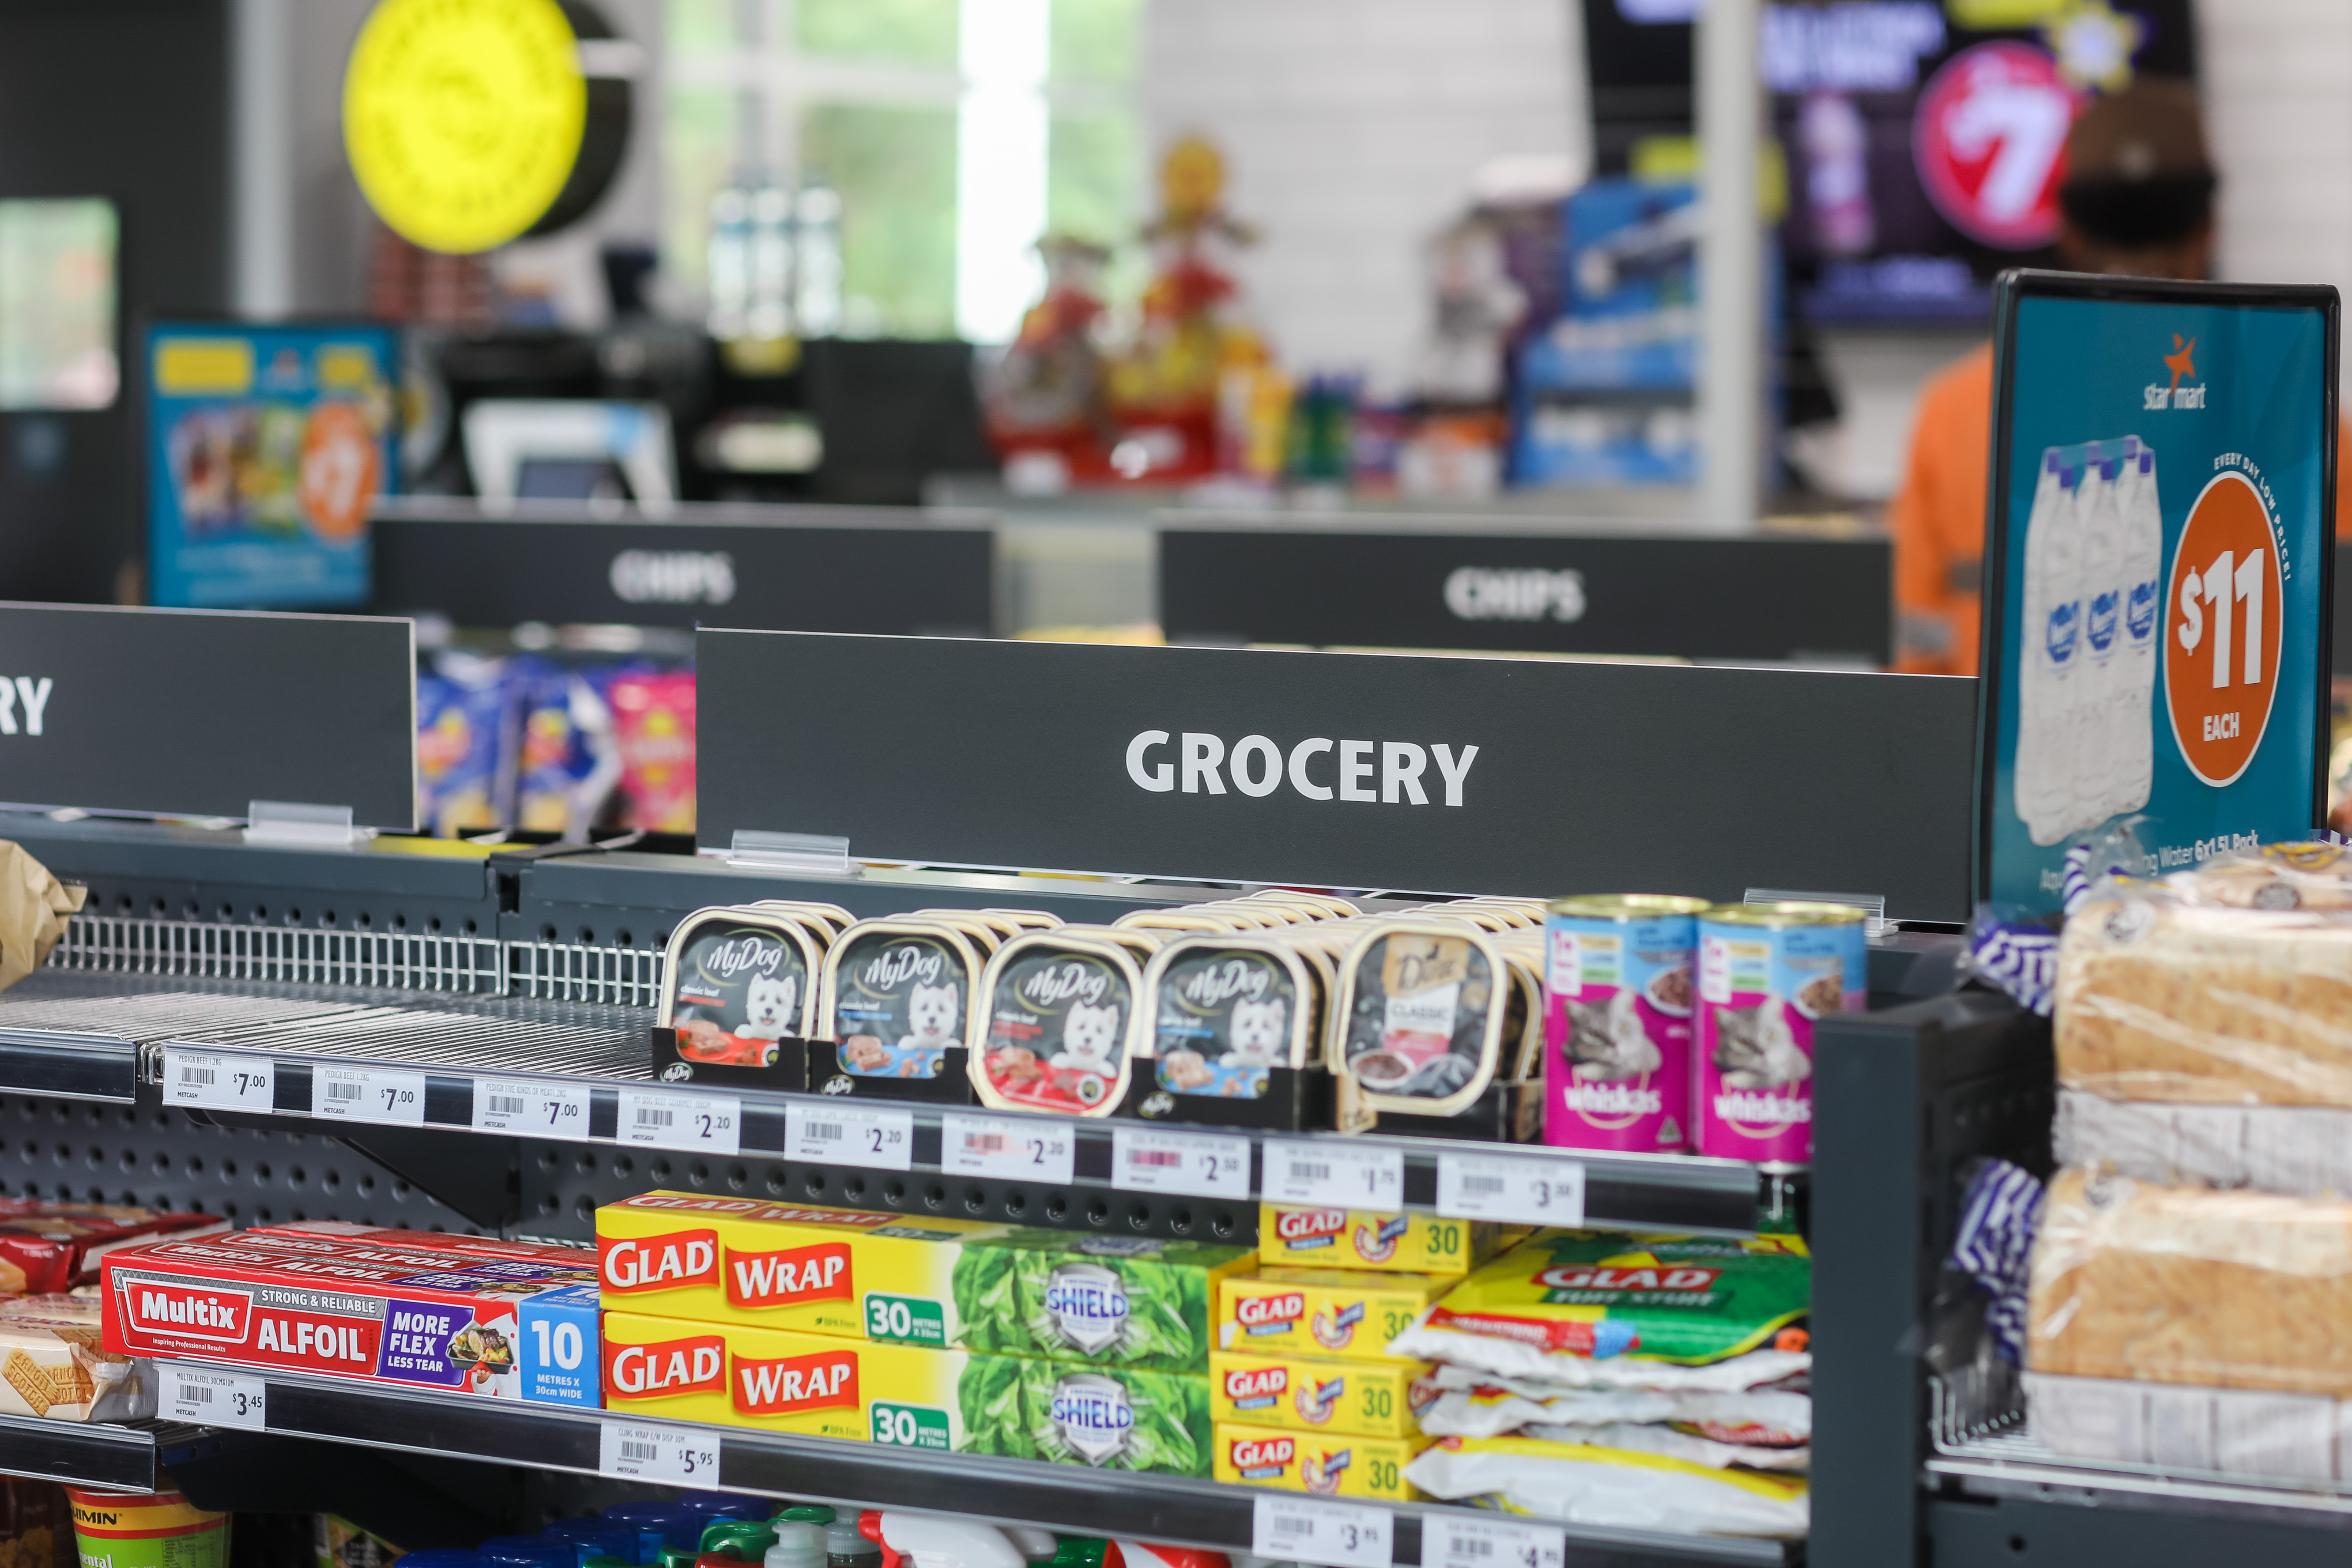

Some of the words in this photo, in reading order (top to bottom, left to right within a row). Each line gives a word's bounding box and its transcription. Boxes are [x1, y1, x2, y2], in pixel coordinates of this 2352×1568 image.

[2173, 382, 2207, 410] mart
[2214, 453, 2242, 470] EVERY
[2243, 457, 2260, 479] DAY
[2260, 477, 2276, 510] LOW
[609, 549, 734, 604] CHIPS
[1445, 567, 1585, 622] CHIPS
[2177, 548, 2265, 689] $11
[2203, 711, 2240, 742] EACH
[1125, 729, 1480, 808] GROCERY
[2159, 845, 2193, 868] Water
[2233, 830, 2259, 852] Pack
[179, 1055, 195, 1065] PEDIGR
[197, 1056, 208, 1065] BEEF
[209, 1058, 222, 1066] 1.2KG
[233, 1073, 266, 1096] $7.00
[325, 1070, 342, 1079] PEDIGR
[344, 1072, 355, 1080] BEEF
[380, 1088, 414, 1111] $7.00
[1564, 1084, 1662, 1114] whiskas
[1713, 1093, 1812, 1124] whiskas
[543, 1102, 578, 1125] $7.00
[695, 1115, 730, 1138] $2.20
[628, 1196, 756, 1213] GLAD
[1279, 1211, 1345, 1237] GLAD
[1427, 1226, 1458, 1254] 30
[272, 1262, 391, 1280] ALFOIL
[344, 1251, 461, 1268] ALFOIL
[605, 1239, 714, 1287] GLAD
[733, 1255, 845, 1299] WRAP
[1541, 1267, 1712, 1288] GLAD
[141, 1291, 236, 1330] Multix
[261, 1290, 307, 1306] STRONG
[310, 1295, 319, 1307] &
[321, 1296, 376, 1314] RELIABLE
[1047, 1288, 1126, 1318] SHIELD
[1238, 1295, 1303, 1324] GLAD
[393, 1311, 450, 1336] MORE
[869, 1299, 911, 1337] 30
[152, 1337, 175, 1348] Inspiring
[175, 1340, 207, 1351] Professional
[208, 1344, 226, 1352] Results
[257, 1318, 367, 1362] ALFOIL
[389, 1333, 437, 1356] FLEX
[531, 1320, 583, 1370] 10
[387, 1355, 414, 1369] LESS
[415, 1358, 443, 1373] TEAR
[612, 1345, 721, 1393] GLAD
[176, 1373, 193, 1382] MULTIX
[194, 1375, 209, 1384] ALFOIL
[210, 1377, 235, 1387] 30CMX10M
[535, 1385, 558, 1397] 30cm
[559, 1386, 583, 1399] WIDE
[537, 1373, 572, 1387] METRES
[573, 1377, 580, 1387] X
[741, 1363, 851, 1406] WRAP
[1226, 1370, 1287, 1397] GLAD
[232, 1393, 262, 1416] $3.45
[1053, 1398, 1132, 1428] SHIELD
[1362, 1388, 1392, 1418] 30
[618, 1428, 634, 1437] CLING
[634, 1430, 649, 1440] WRAP
[875, 1407, 917, 1446] 30
[679, 1449, 713, 1473] $5.95
[1233, 1440, 1294, 1468] GLAD
[616, 1466, 639, 1475] METCASH
[1369, 1460, 1399, 1490] 30
[73, 1506, 117, 1525] UIMIN
